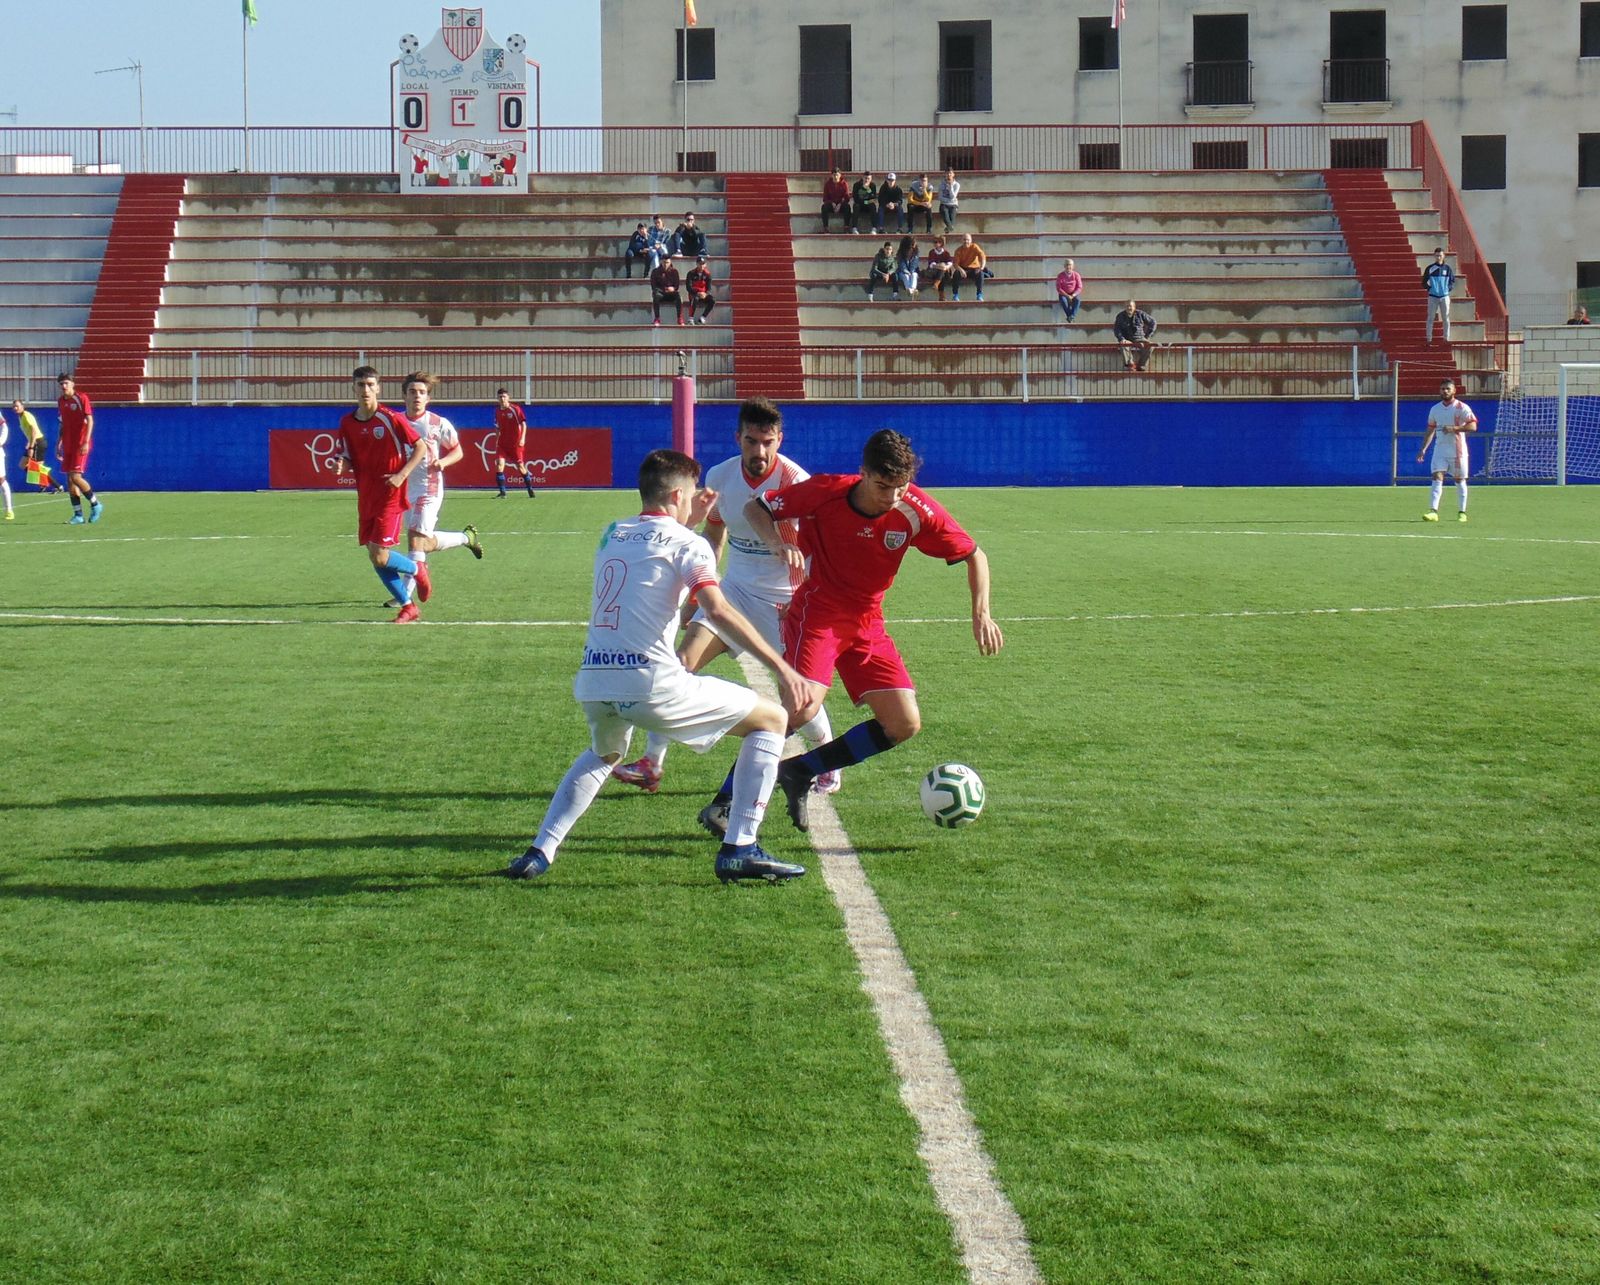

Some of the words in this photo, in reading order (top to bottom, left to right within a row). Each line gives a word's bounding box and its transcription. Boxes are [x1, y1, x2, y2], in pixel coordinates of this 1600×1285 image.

[404, 97, 422, 128] 0
[458, 102, 466, 121] 1
[503, 97, 522, 128] 0
[507, 476, 546, 484] deprtes
[906, 492, 935, 517] KELME
[611, 530, 673, 547] agroGM
[594, 558, 628, 630] 2
